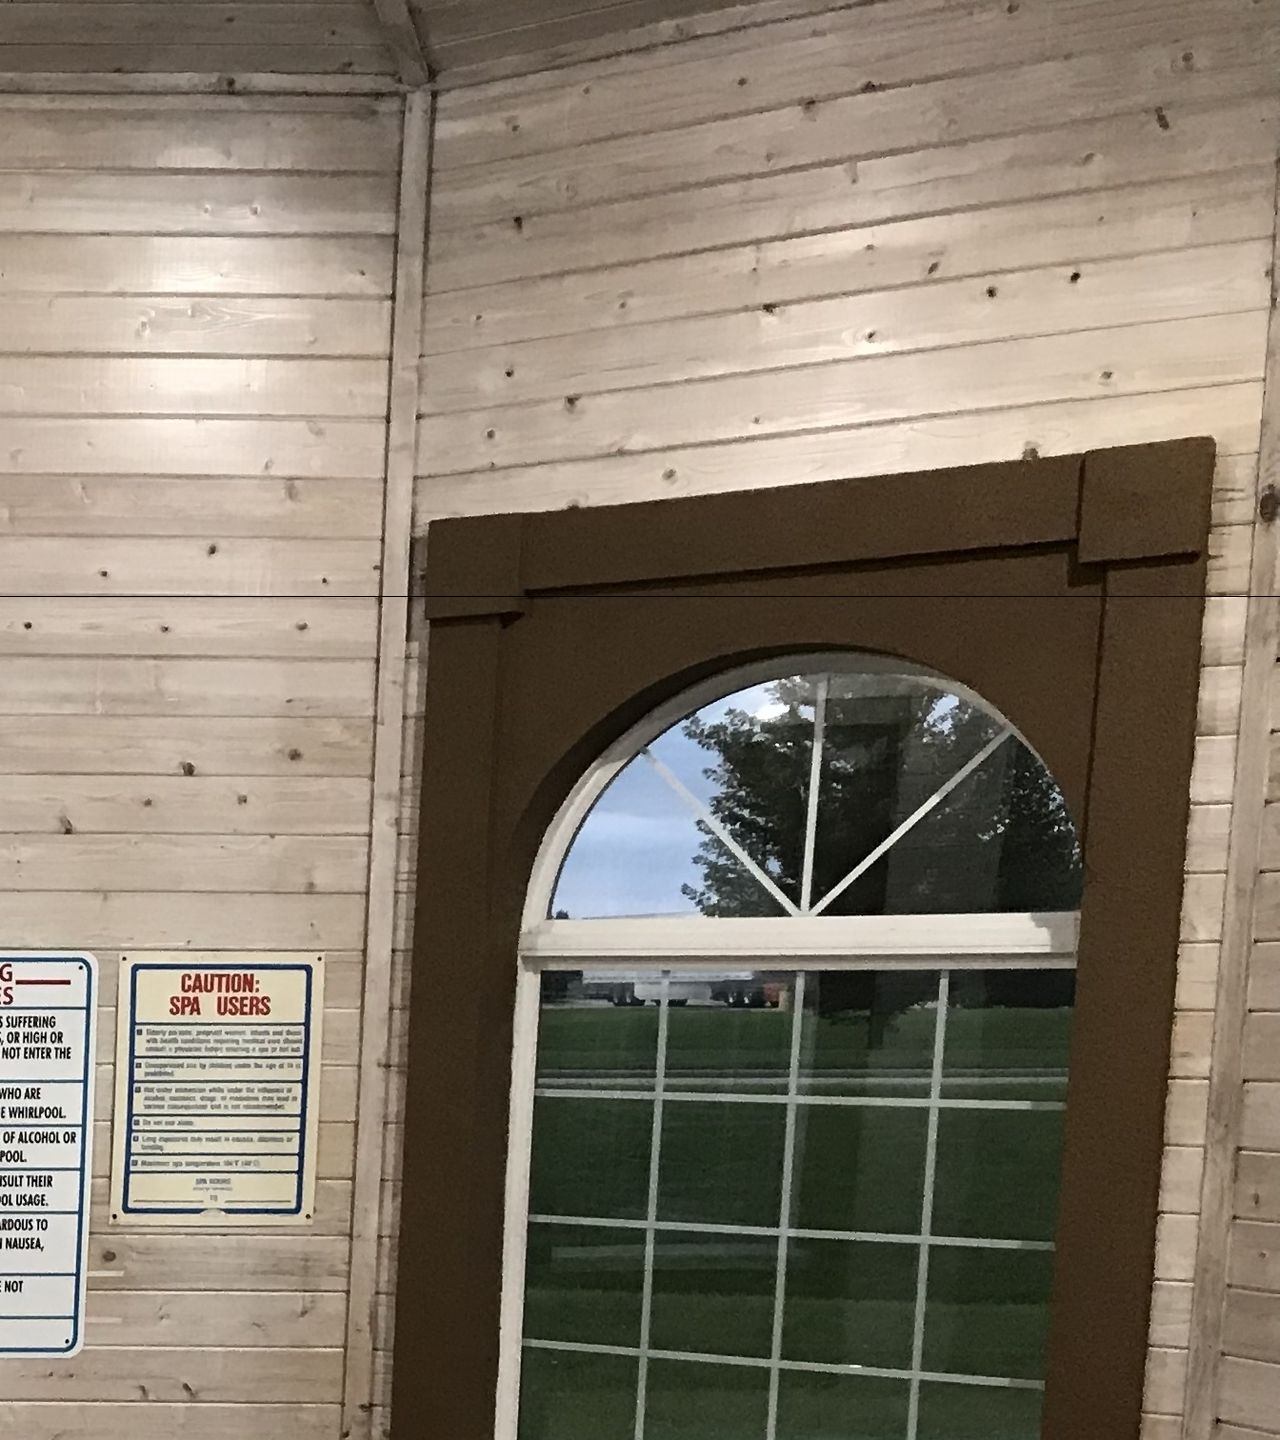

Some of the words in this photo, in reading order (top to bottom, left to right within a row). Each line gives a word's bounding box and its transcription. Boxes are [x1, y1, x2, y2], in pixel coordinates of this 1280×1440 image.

[180, 973, 260, 993] CAUTION:
[169, 996, 201, 1016] SPA
[216, 996, 272, 1016] USERS
[6, 1015, 56, 1028] SUFFERING
[6, 1031, 20, 1044] OR
[22, 1031, 47, 1044] HIGH
[50, 1031, 64, 1044] OR
[2, 1046, 22, 1060] NOT
[23, 1046, 52, 1060] ENTER
[54, 1046, 72, 1060] THE
[24, 1087, 41, 1100] ARE
[8, 1106, 66, 1119] WHIRLPOOL.
[3, 1131, 16, 1144] OF
[17, 1131, 60, 1144] ALCOHOL
[63, 1131, 76, 1144] OR
[26, 1175, 53, 1188] THEIR
[16, 1194, 49, 1206] USAGE.
[36, 1218, 48, 1231] TO
[5, 1237, 44, 1252] NAUSEA,
[4, 1280, 24, 1293] NOT
